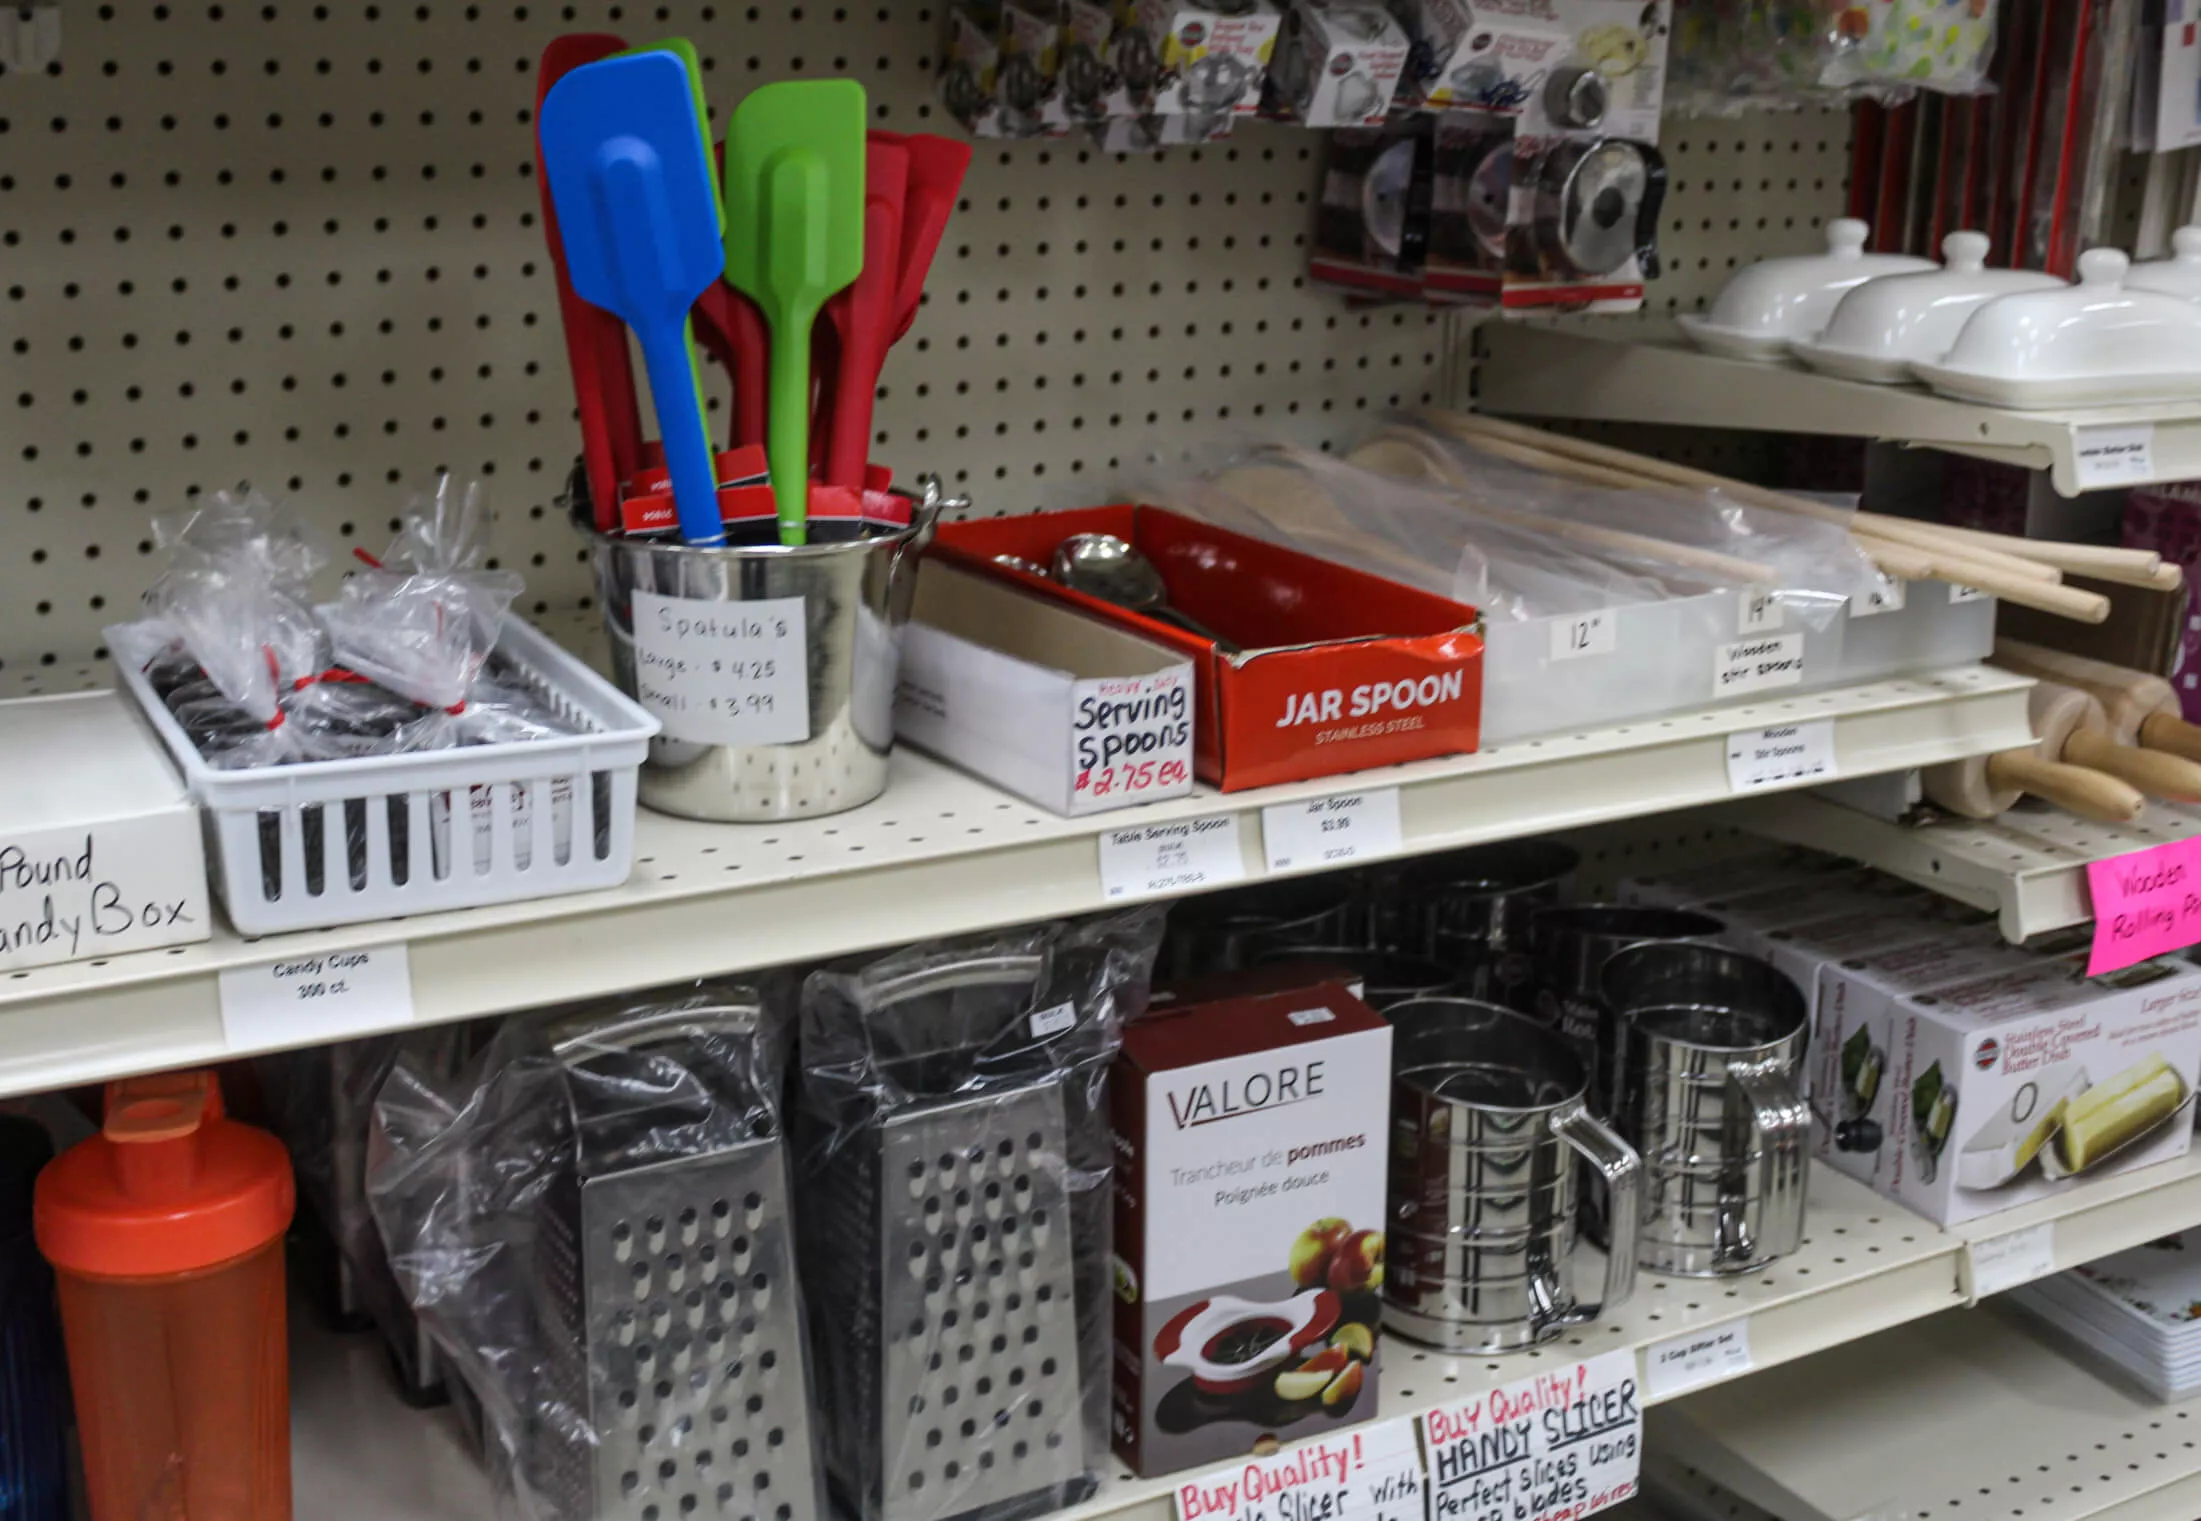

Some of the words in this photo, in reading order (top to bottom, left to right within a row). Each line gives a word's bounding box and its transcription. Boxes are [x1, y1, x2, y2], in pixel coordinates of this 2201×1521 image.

[658, 605, 788, 640] Spatula's
[1074, 685, 1187, 731] Serving
[1275, 688, 1344, 729] JAR
[1348, 668, 1465, 718] SPOON
[1314, 721, 1385, 745] STAINLESS
[1386, 715, 1425, 734] STEEL
[1111, 830, 1142, 846] Table
[1145, 825, 1189, 841] Serving
[1192, 817, 1230, 833] Spoon
[0, 832, 93, 893] Pound
[0, 894, 82, 957] andy
[91, 880, 196, 937] Box
[272, 959, 325, 979] Candy
[328, 952, 370, 970] Cups
[297, 981, 327, 1000] 300
[1167, 1060, 1327, 1131] VALORE
[1170, 1154, 1257, 1187] Trancheur
[1260, 1149, 1284, 1169] de
[1286, 1132, 1367, 1168] pommes
[1281, 1169, 1331, 1194] douce
[1436, 1417, 1533, 1482] HANDY
[1543, 1378, 1639, 1445] SLICER
[1179, 1480, 1239, 1521] Buy
[1242, 1433, 1365, 1504] Quality!
[1435, 1468, 1513, 1521] Perfect
[1514, 1478, 1588, 1520] blades
